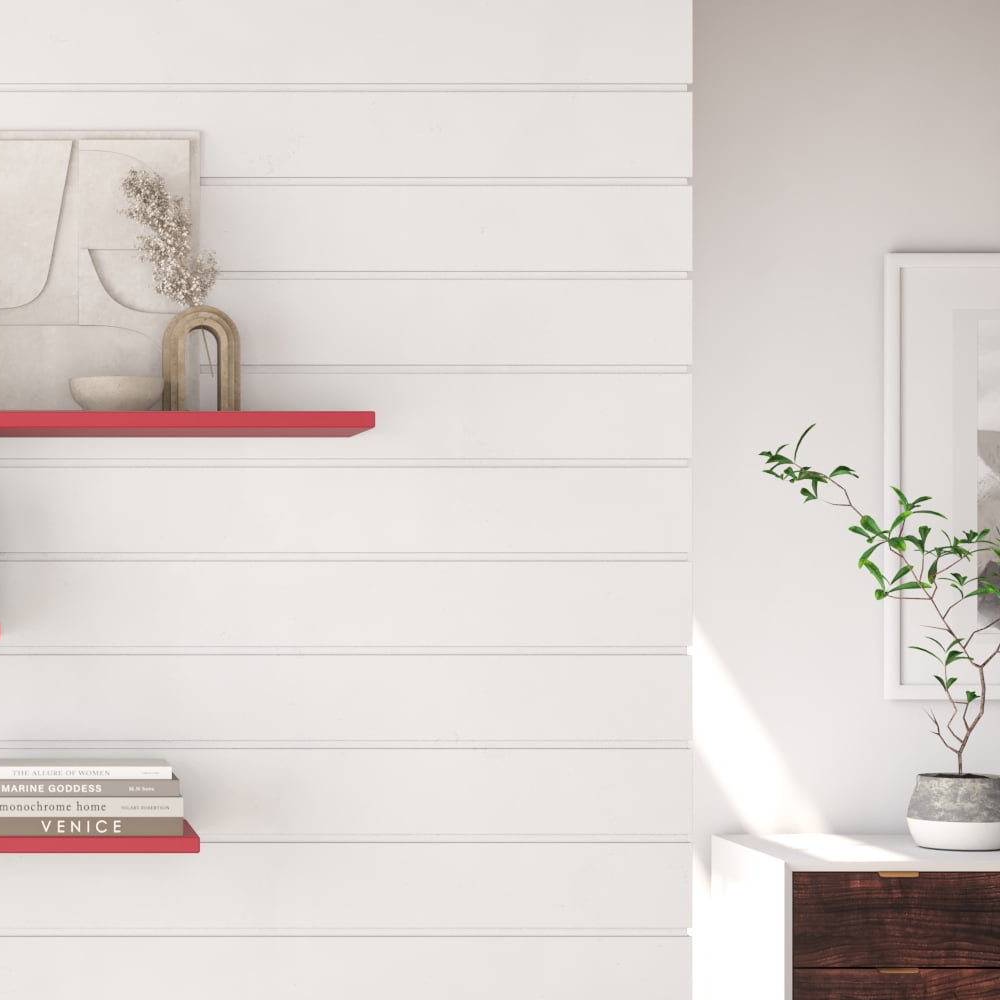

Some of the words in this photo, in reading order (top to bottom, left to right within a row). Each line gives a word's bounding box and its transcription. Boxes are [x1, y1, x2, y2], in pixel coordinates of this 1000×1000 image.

[1, 784, 44, 793] MARINE
[48, 784, 102, 793] GODDESS
[0, 801, 72, 812] monochrome
[77, 801, 107, 812] home
[41, 820, 121, 833] VENICE
